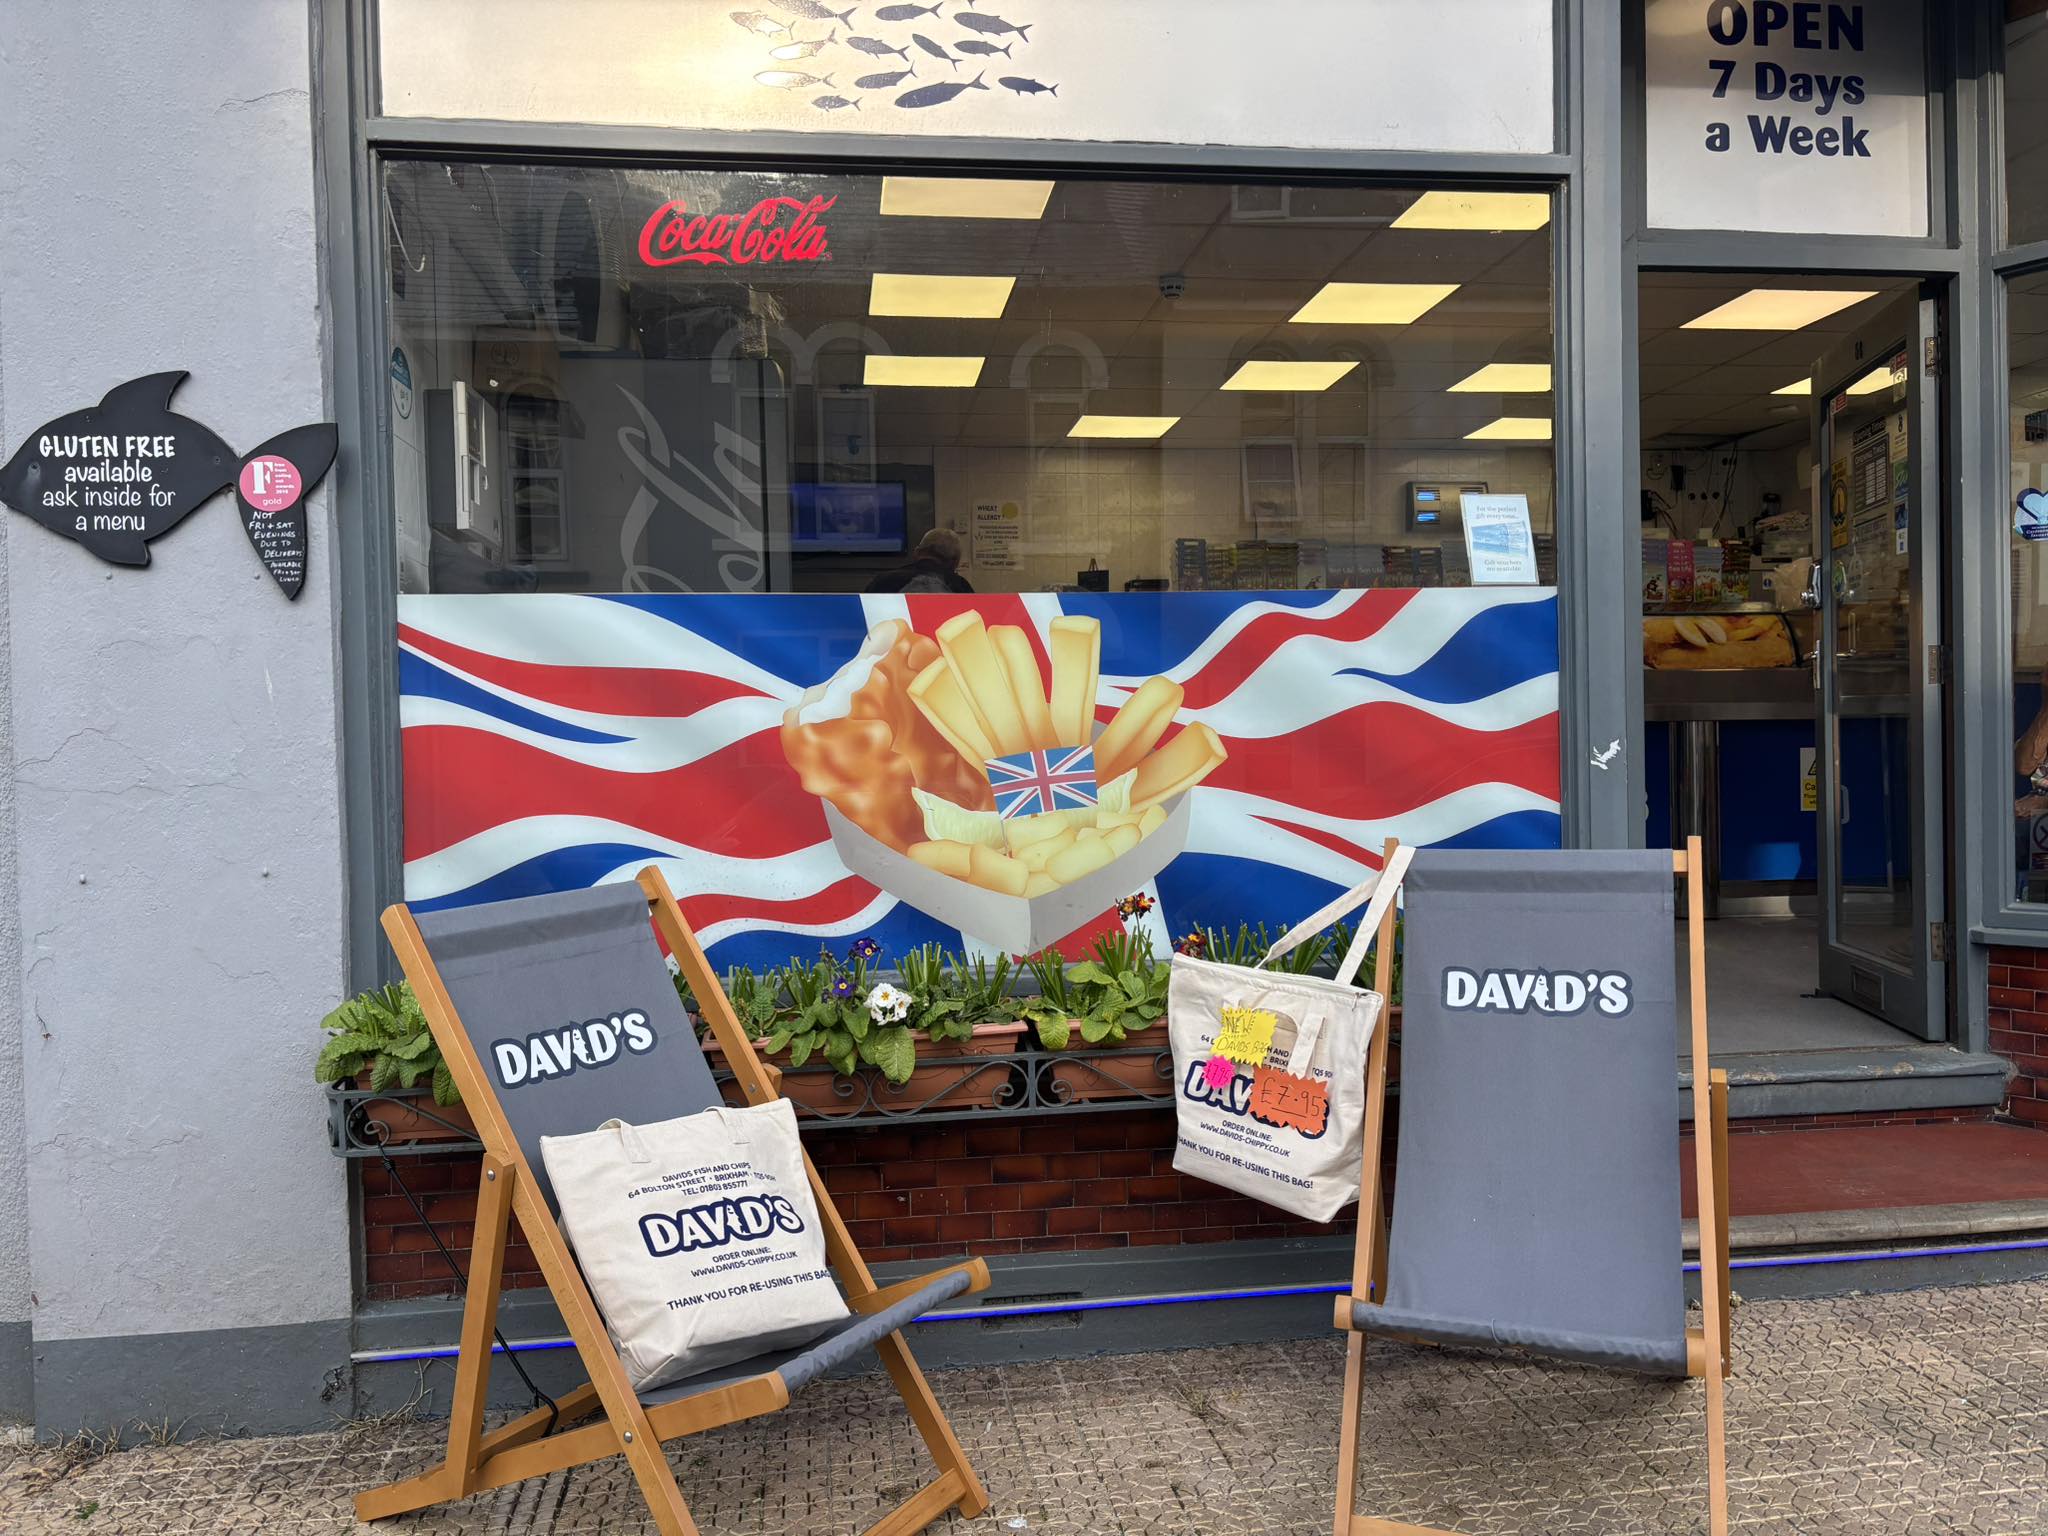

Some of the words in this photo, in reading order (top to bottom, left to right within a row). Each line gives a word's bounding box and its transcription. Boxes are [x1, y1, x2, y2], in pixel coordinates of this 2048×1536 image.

[1707, 0, 1864, 51] OPEN
[1708, 60, 1736, 98] 7
[1755, 62, 1865, 116] Days
[1705, 122, 1731, 152] a
[1747, 115, 1872, 157] Week
[638, 194, 838, 267] Coca-Cola
[40, 436, 118, 458] GLUTEN
[125, 436, 176, 458] FREE
[64, 459, 152, 483] available
[42, 485, 78, 507] ask
[85, 485, 142, 507] inside
[149, 484, 176, 507] for
[262, 498, 282, 507] gold
[76, 517, 87, 531] a
[94, 515, 145, 531] menu
[249, 521, 265, 530] FRI
[252, 511, 276, 520] NOT
[254, 530, 296, 539] EVENINGS
[260, 540, 278, 548] DUE
[1444, 969, 1630, 1016] DAVID'S
[1225, 1014, 1251, 1034] NEW
[493, 1010, 655, 1086] DAVID'S
[1273, 1049, 1289, 1058] AND
[1261, 1076, 1324, 1118] £7.95
[1200, 1121, 1291, 1158] WWW.DAVIDS-CHIPPY.CO.UK
[1222, 1120, 1245, 1133] ORDER
[1246, 1127, 1272, 1142] ONLINE:
[662, 1170, 693, 1183] DAVIDS
[694, 1166, 712, 1176] FISH
[713, 1163, 730, 1174] AND
[730, 1161, 751, 1171] CHIPS
[1178, 1136, 1198, 1151] HANK
[1199, 1144, 1214, 1157] YOU
[1215, 1151, 1231, 1163] FOR
[1232, 1158, 1270, 1177] RE-USING
[1271, 1170, 1290, 1184] THIS
[1291, 1176, 1313, 1189] BAG!
[628, 1189, 641, 1199] 64
[641, 1182, 675, 1194] BOLTON
[675, 1176, 706, 1189] STREET
[714, 1170, 749, 1181] BRIXHAM
[682, 1187, 699, 1197] TEL:
[699, 1183, 722, 1194] 01803
[722, 1180, 748, 1190] 855771
[642, 1197, 803, 1254] DAVID'S
[691, 1250, 798, 1277] WWW.DAVIDS-CHIPPY.CO.UK
[712, 1251, 741, 1263] ORDER
[741, 1246, 771, 1258] ONLINE:
[667, 1294, 704, 1311] THANK
[704, 1289, 727, 1302] YOU
[729, 1284, 748, 1298] FOR
[749, 1276, 793, 1293] RE-USING
[793, 1272, 814, 1285] THIS
